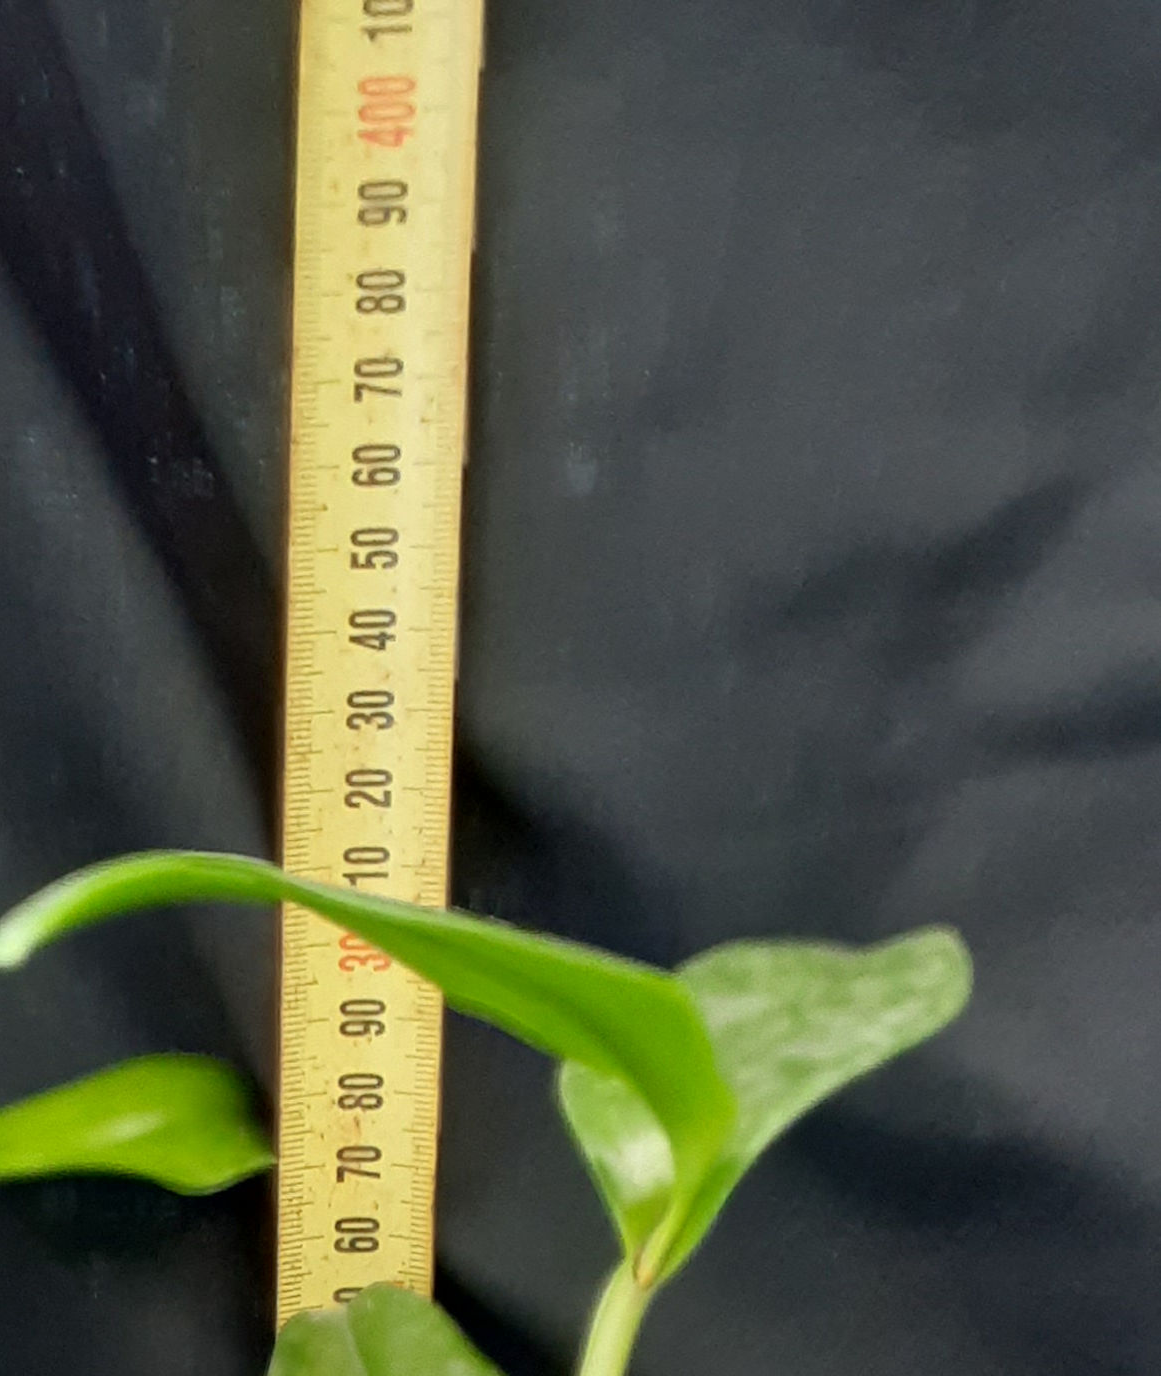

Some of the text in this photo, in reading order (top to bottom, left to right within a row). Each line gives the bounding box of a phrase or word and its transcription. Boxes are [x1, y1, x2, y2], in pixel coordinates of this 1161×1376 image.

[361, 0, 414, 43] 10
[357, 76, 416, 148] 400
[356, 180, 408, 228] 90
[355, 269, 406, 315] 80
[353, 356, 404, 403] 70
[351, 444, 401, 487] 60
[349, 527, 399, 570] 50
[348, 609, 397, 651] 40
[345, 690, 395, 731] 30
[343, 768, 393, 809] 20
[342, 846, 390, 886] 10
[338, 932, 392, 972] 30
[338, 999, 386, 1037] 90
[337, 1073, 384, 1112] 80
[335, 1145, 382, 1184] 70
[333, 1216, 380, 1254] 60
